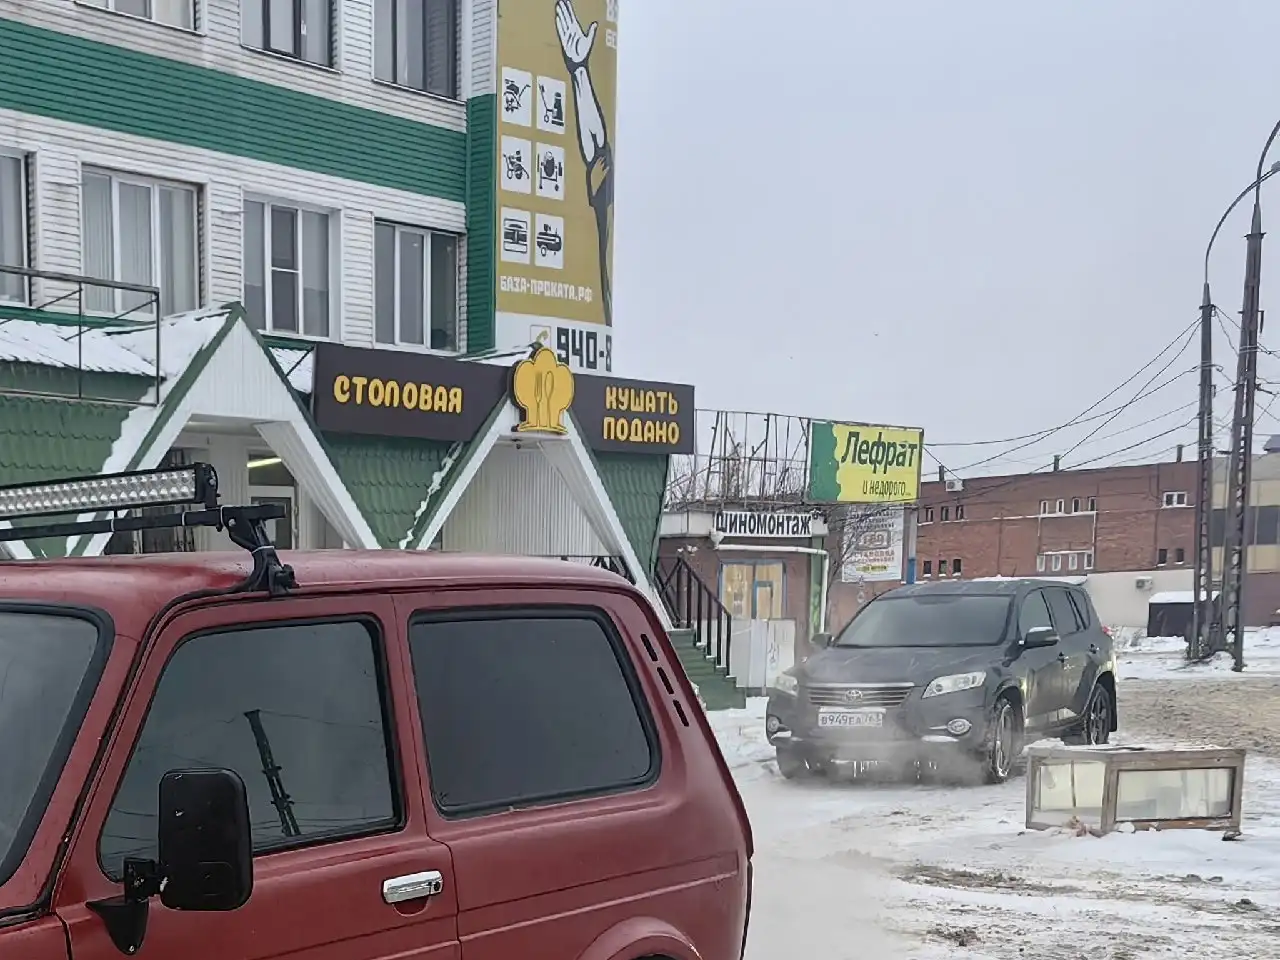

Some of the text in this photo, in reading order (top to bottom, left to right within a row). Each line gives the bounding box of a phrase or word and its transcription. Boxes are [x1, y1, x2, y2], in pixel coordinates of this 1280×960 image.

[333, 375, 463, 414] СТОЛОВАЯ
[605, 385, 679, 415] КУШАТЬ
[603, 416, 680, 445] ПОДАНО
[841, 431, 918, 475] Лефрат
